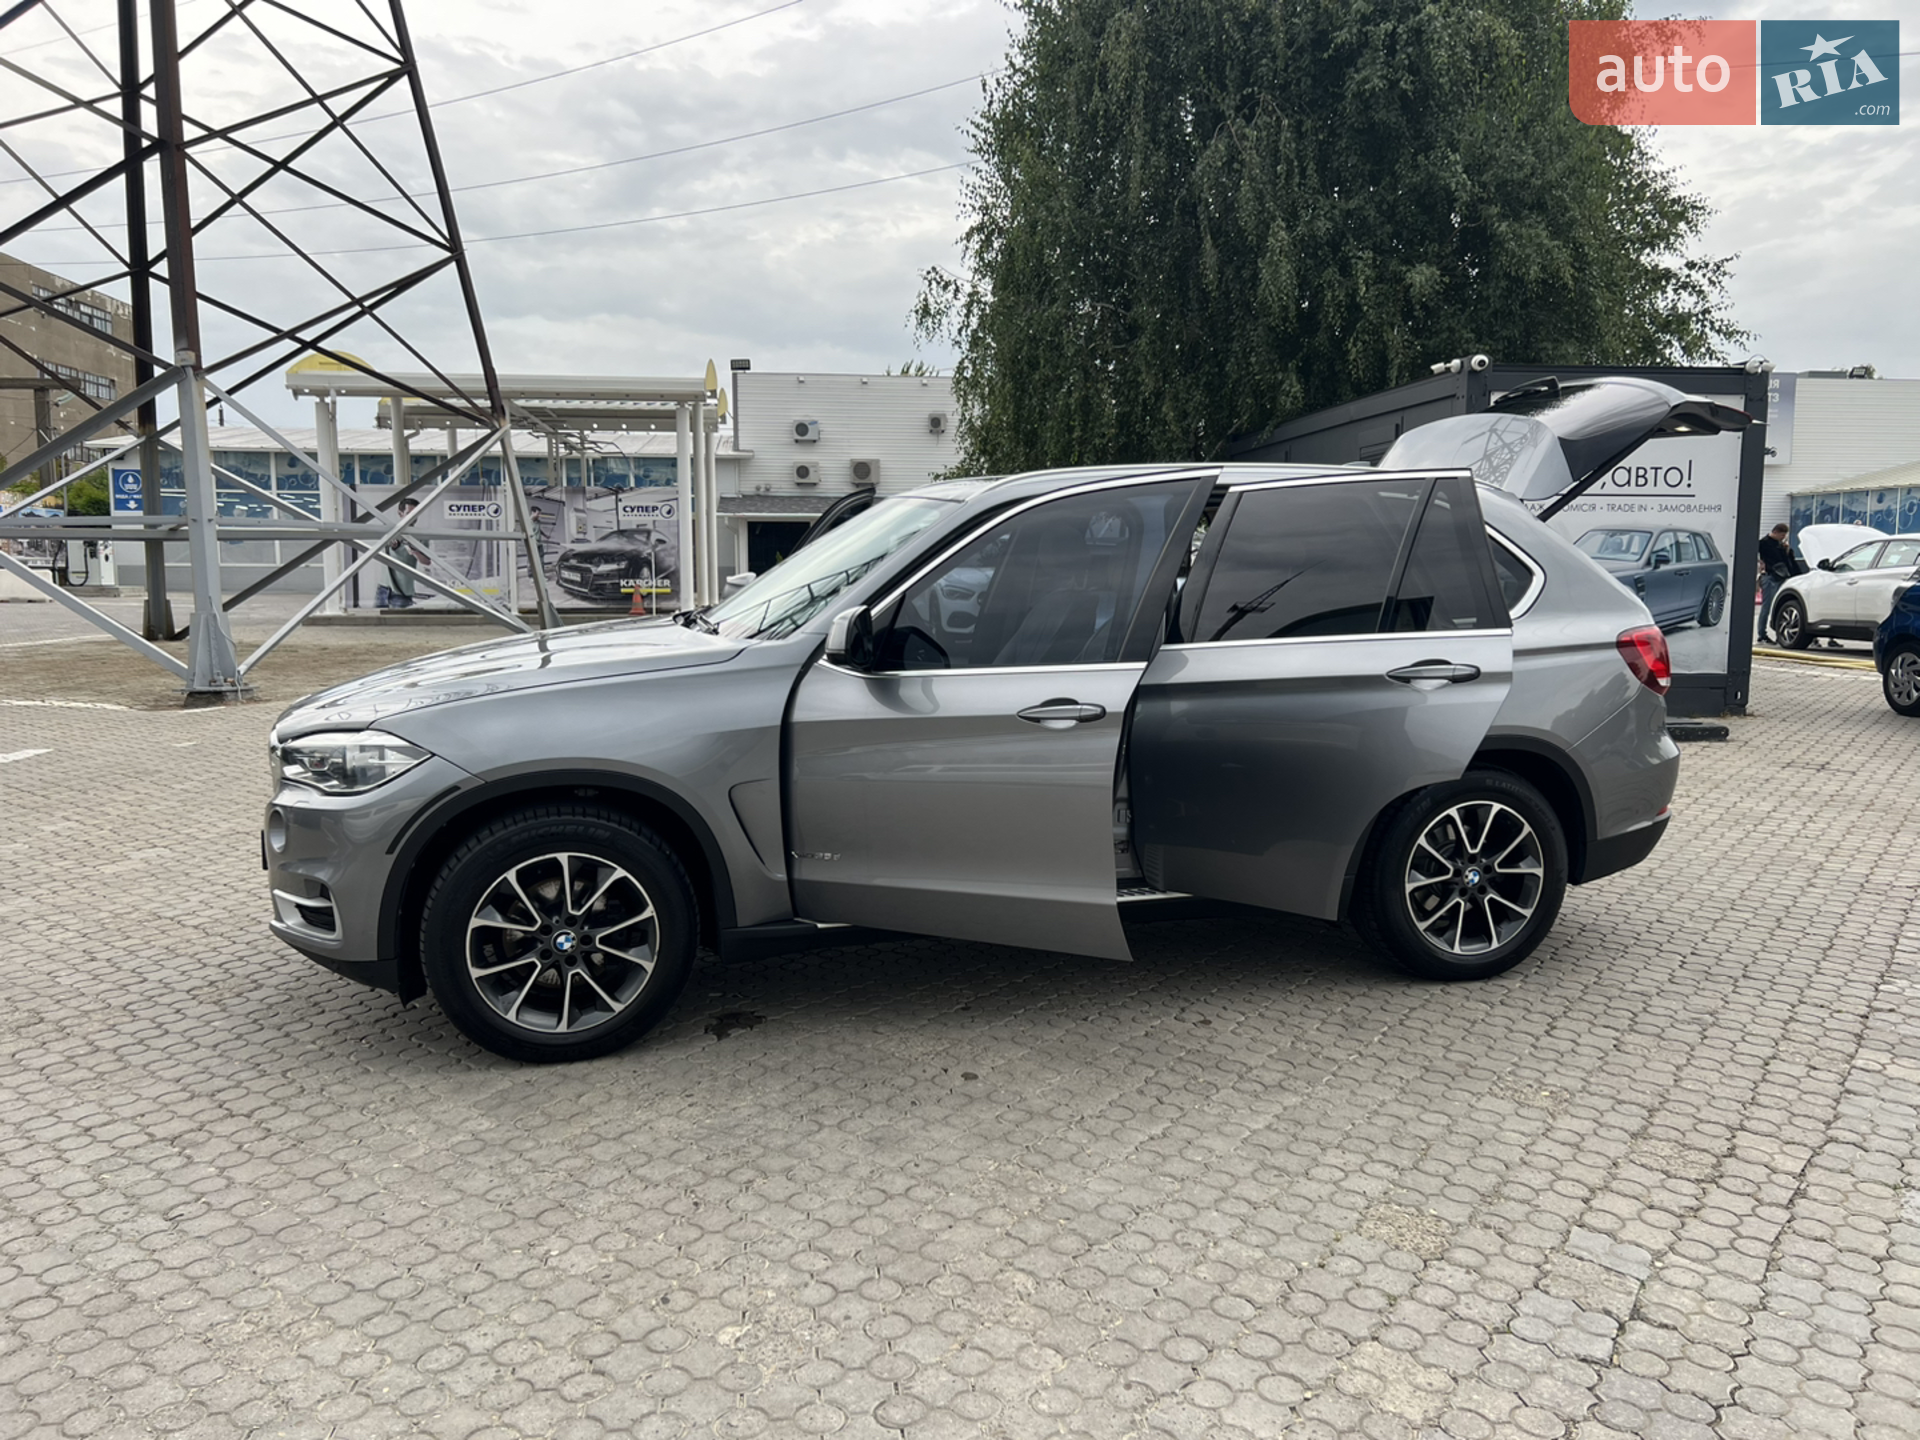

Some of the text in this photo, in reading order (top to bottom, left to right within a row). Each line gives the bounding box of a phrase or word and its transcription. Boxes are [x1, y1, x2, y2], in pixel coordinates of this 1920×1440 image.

[448, 504, 486, 512] СУПЕР
[622, 505, 659, 513] СУПЕР
[1562, 503, 1596, 513] ОМІСІЯ
[1606, 503, 1648, 513] TRADE IN
[1656, 503, 1722, 514] ЗАМОВЛЕННЯ
